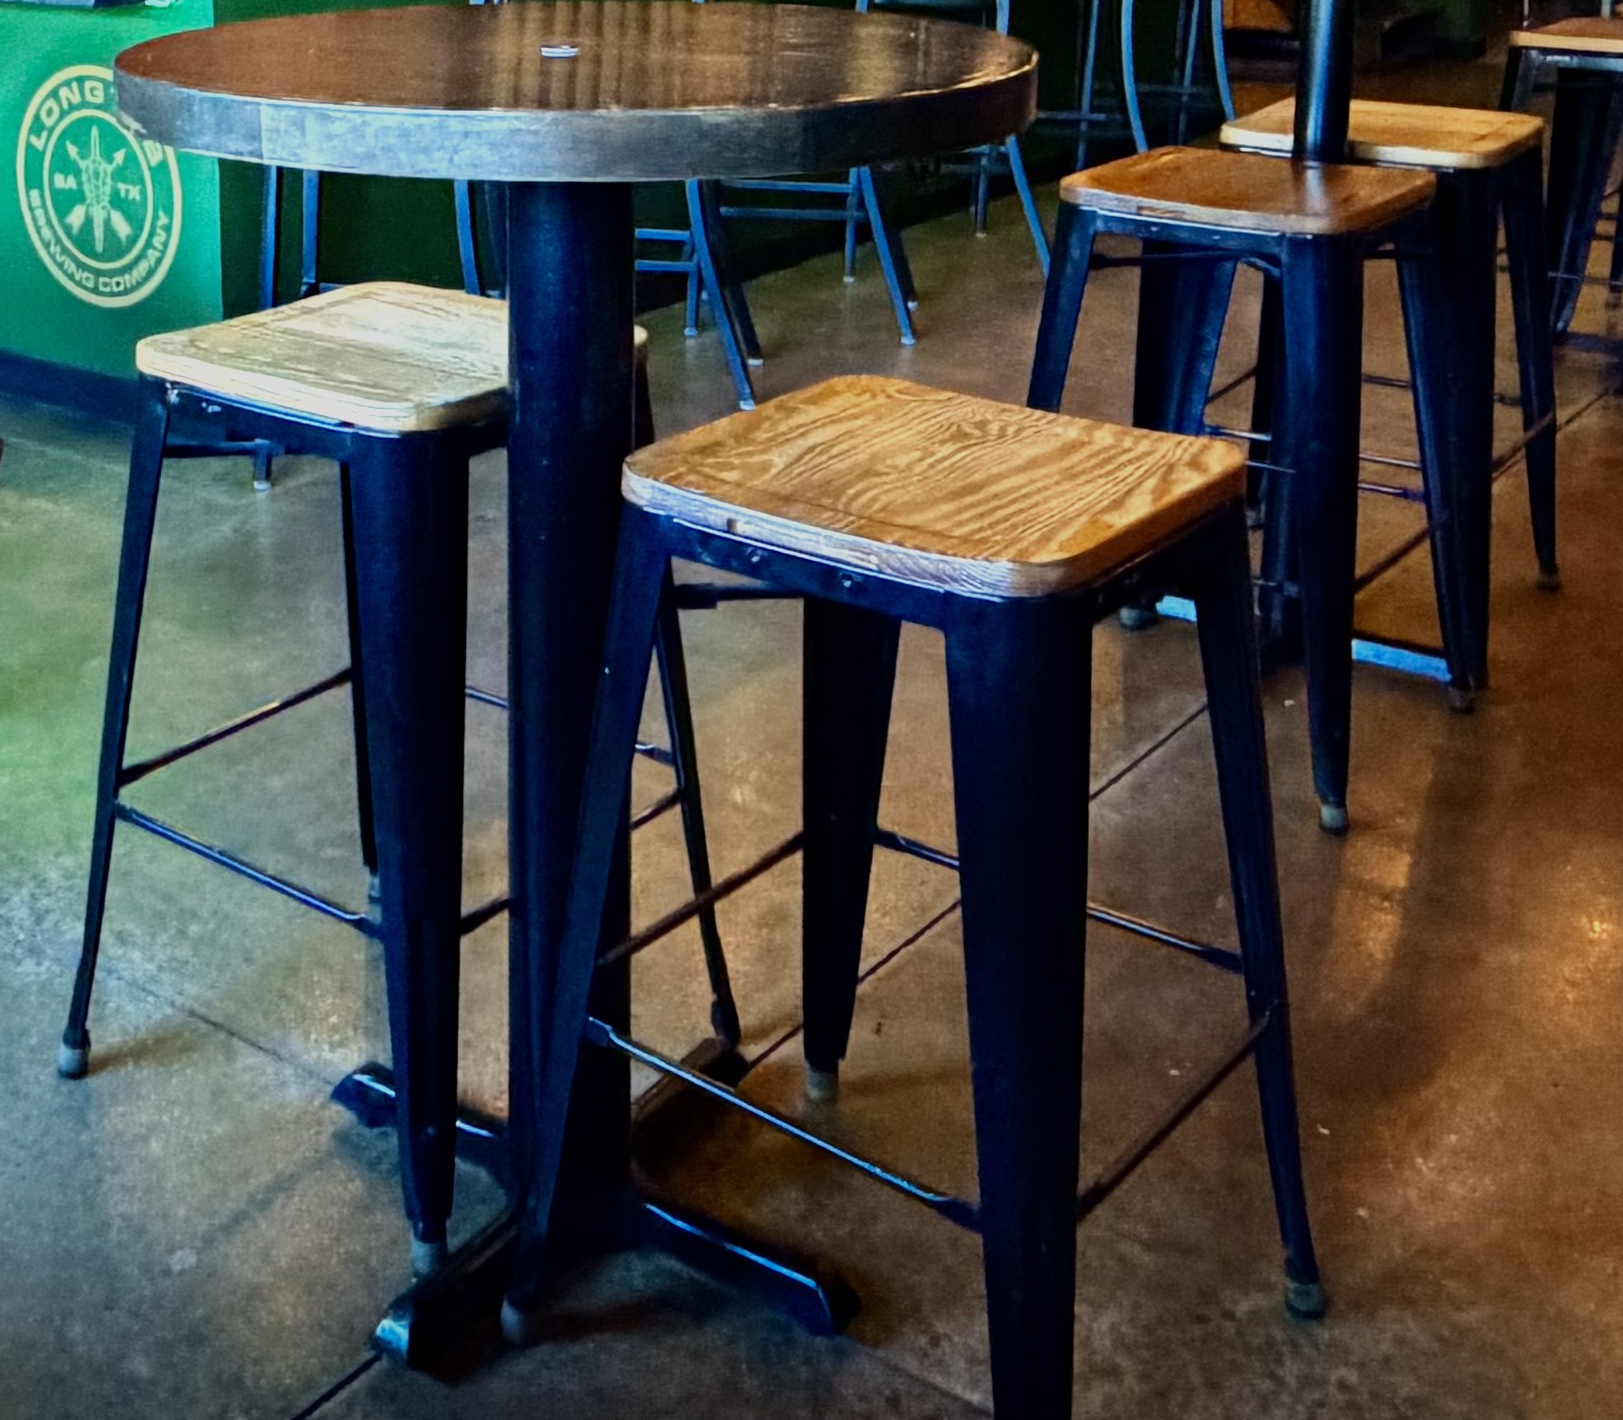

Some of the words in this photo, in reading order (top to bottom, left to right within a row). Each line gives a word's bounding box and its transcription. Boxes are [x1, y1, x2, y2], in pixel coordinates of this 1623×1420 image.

[116, 182, 141, 200] TX
[29, 189, 95, 287] BREWING
[98, 210, 170, 292] COMPANY
